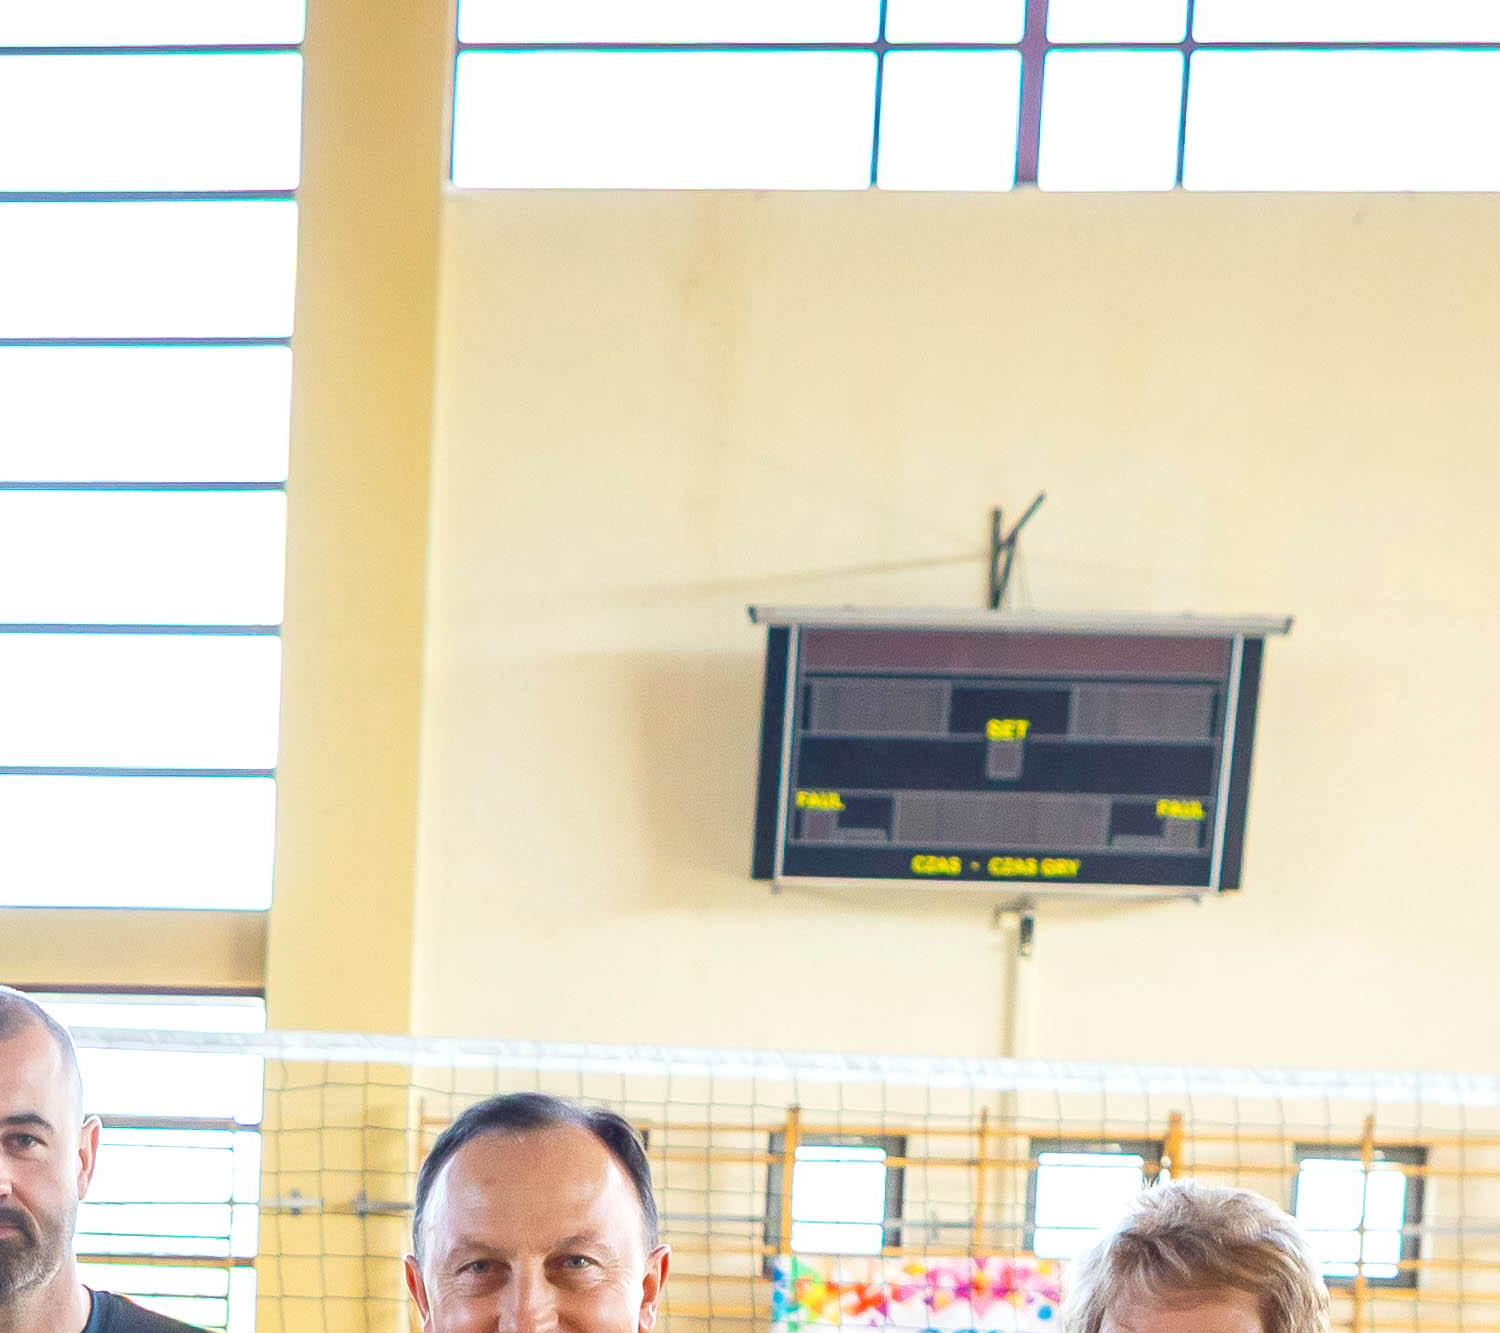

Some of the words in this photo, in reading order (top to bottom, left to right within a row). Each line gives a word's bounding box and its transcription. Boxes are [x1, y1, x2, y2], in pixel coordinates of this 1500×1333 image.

[985, 718, 1031, 741] SET
[796, 790, 845, 811] FAUL
[1156, 799, 1206, 820] FAUL
[911, 855, 962, 876] CZAS
[988, 857, 1039, 877] CZAS
[1040, 857, 1081, 877] GRY
